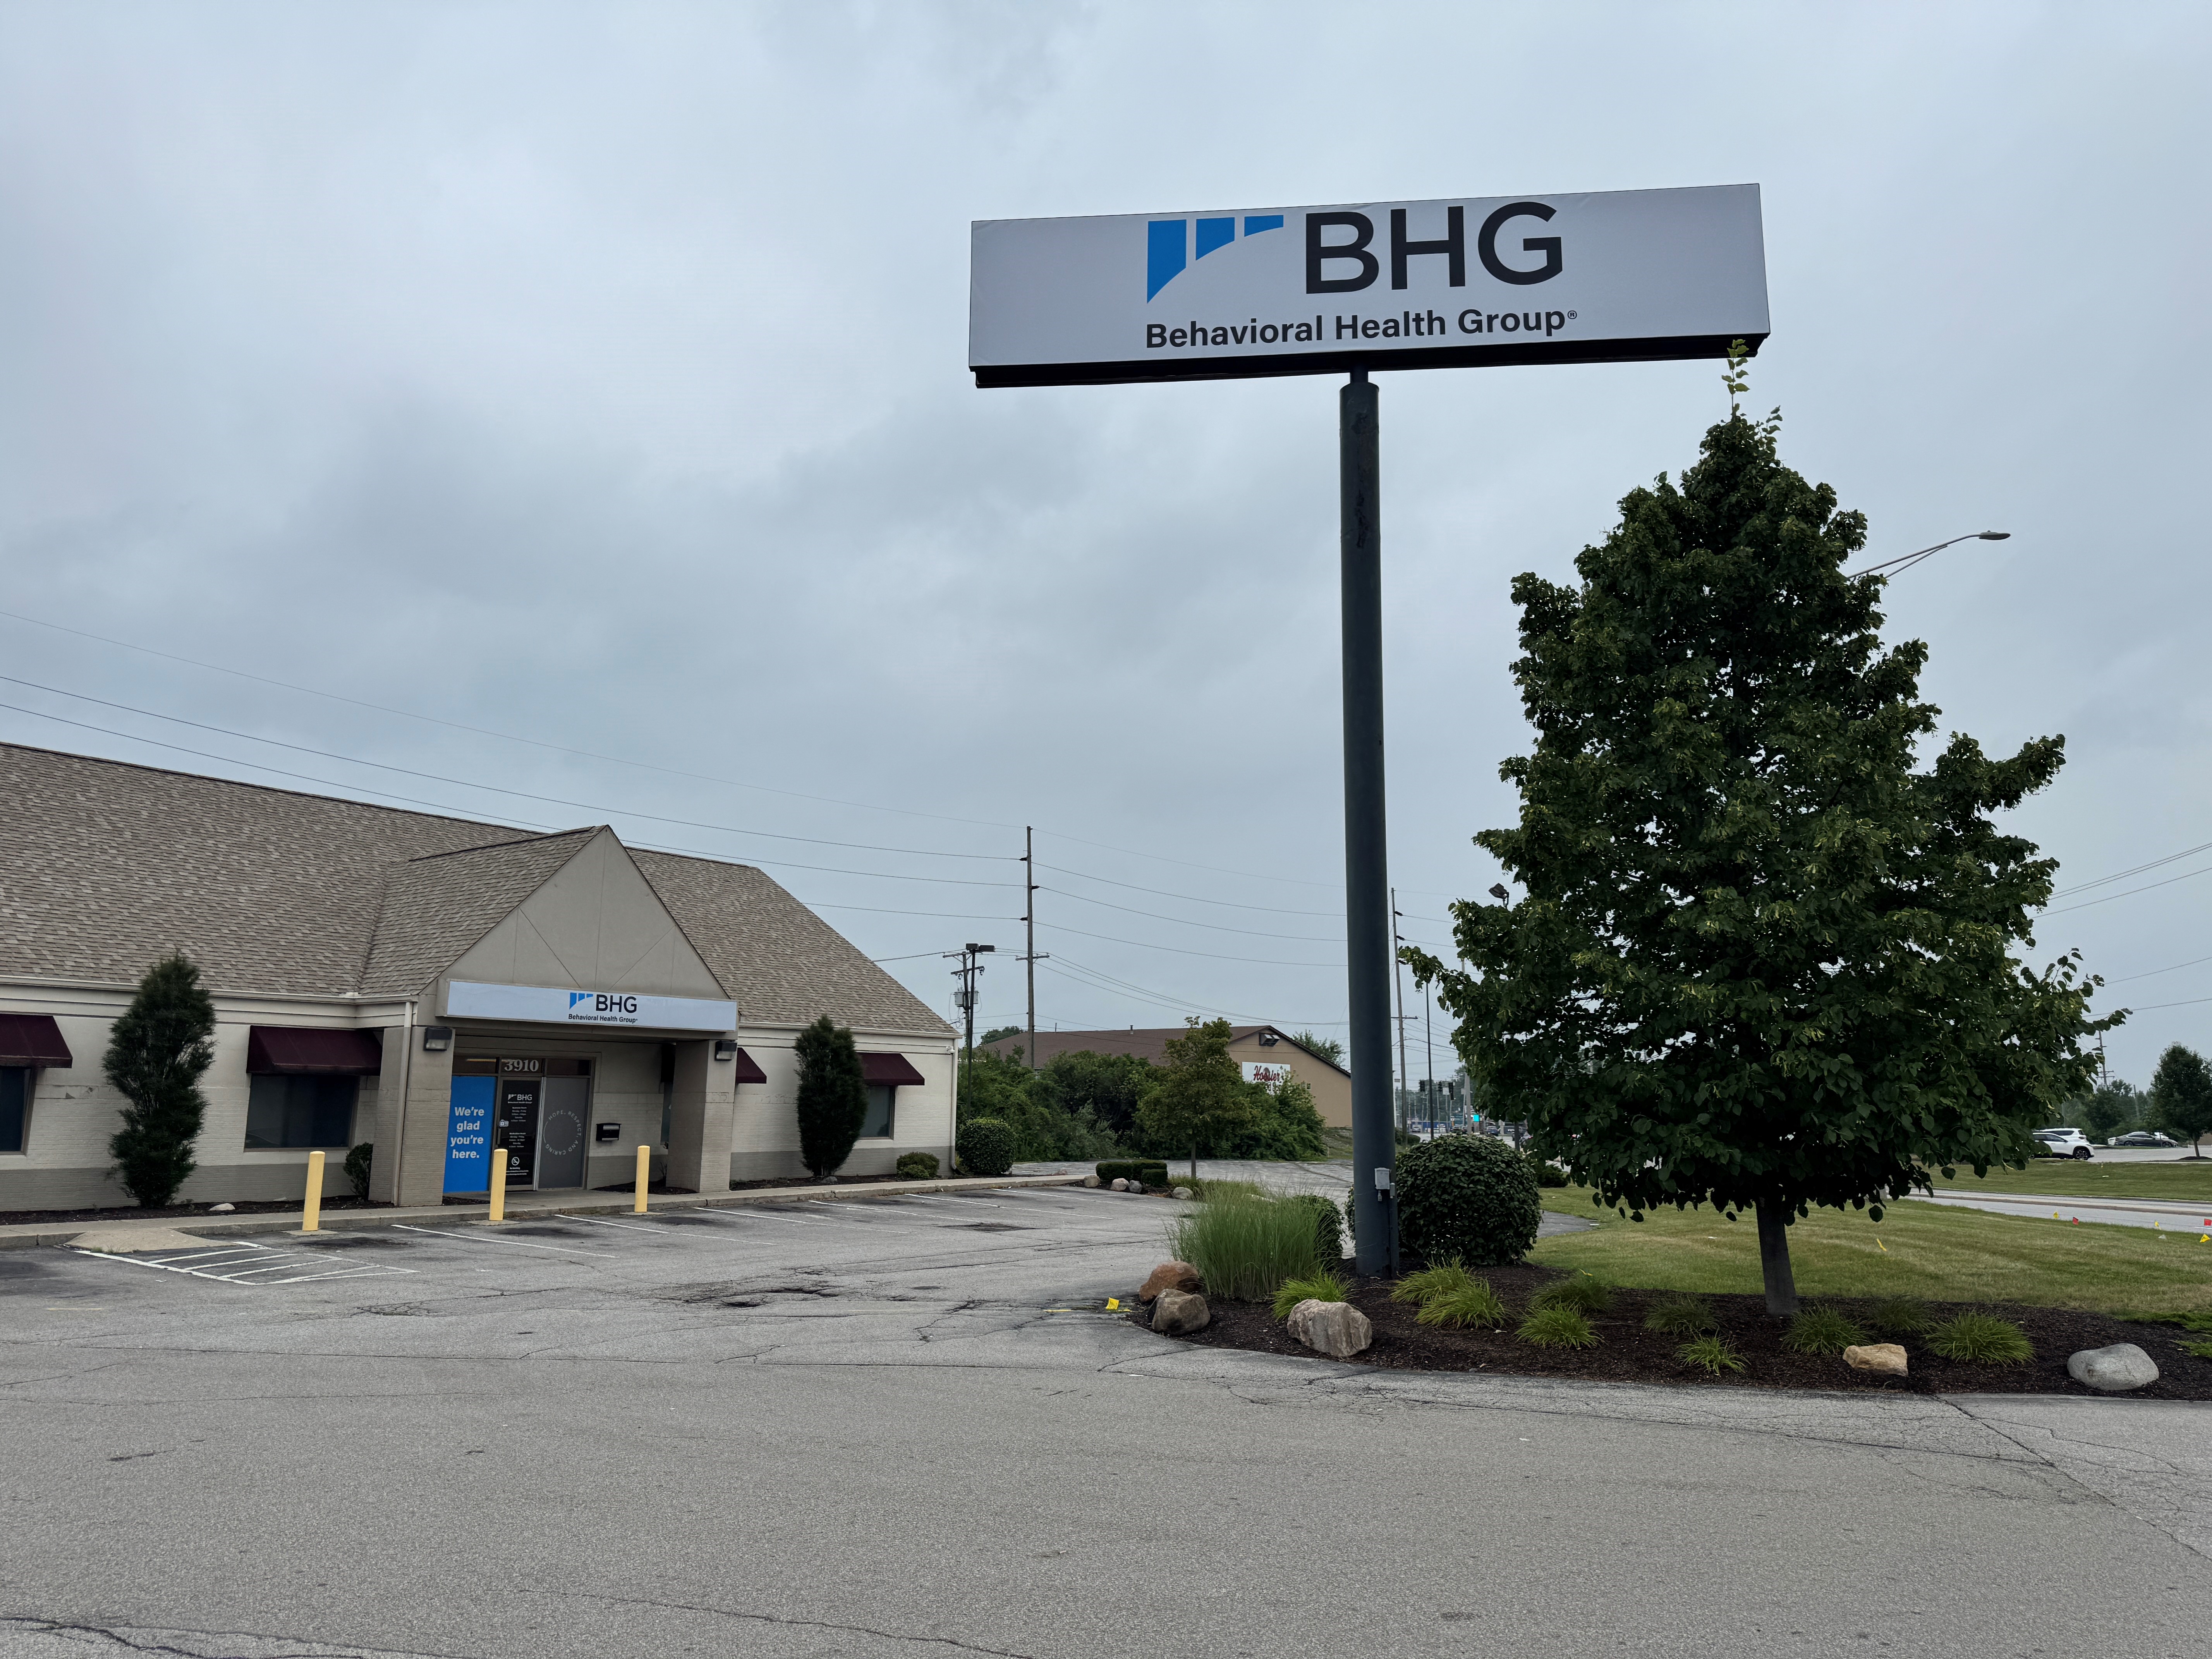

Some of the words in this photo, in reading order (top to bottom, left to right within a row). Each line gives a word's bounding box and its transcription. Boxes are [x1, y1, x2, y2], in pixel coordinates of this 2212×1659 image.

[1305, 201, 1563, 294] BHG
[1146, 314, 1323, 348] Behavioral
[1336, 309, 1446, 340] Health
[596, 994, 637, 1013] BHG
[504, 1059, 539, 1072] 3910
[454, 1107, 484, 1116] We’re
[456, 1121, 480, 1132] glad
[568, 1111, 581, 1137] RESPECT,
[450, 1135, 484, 1147] you’re
[568, 1140, 578, 1152] AND
[452, 1149, 480, 1159] here.
[545, 1144, 566, 1155] CARING
